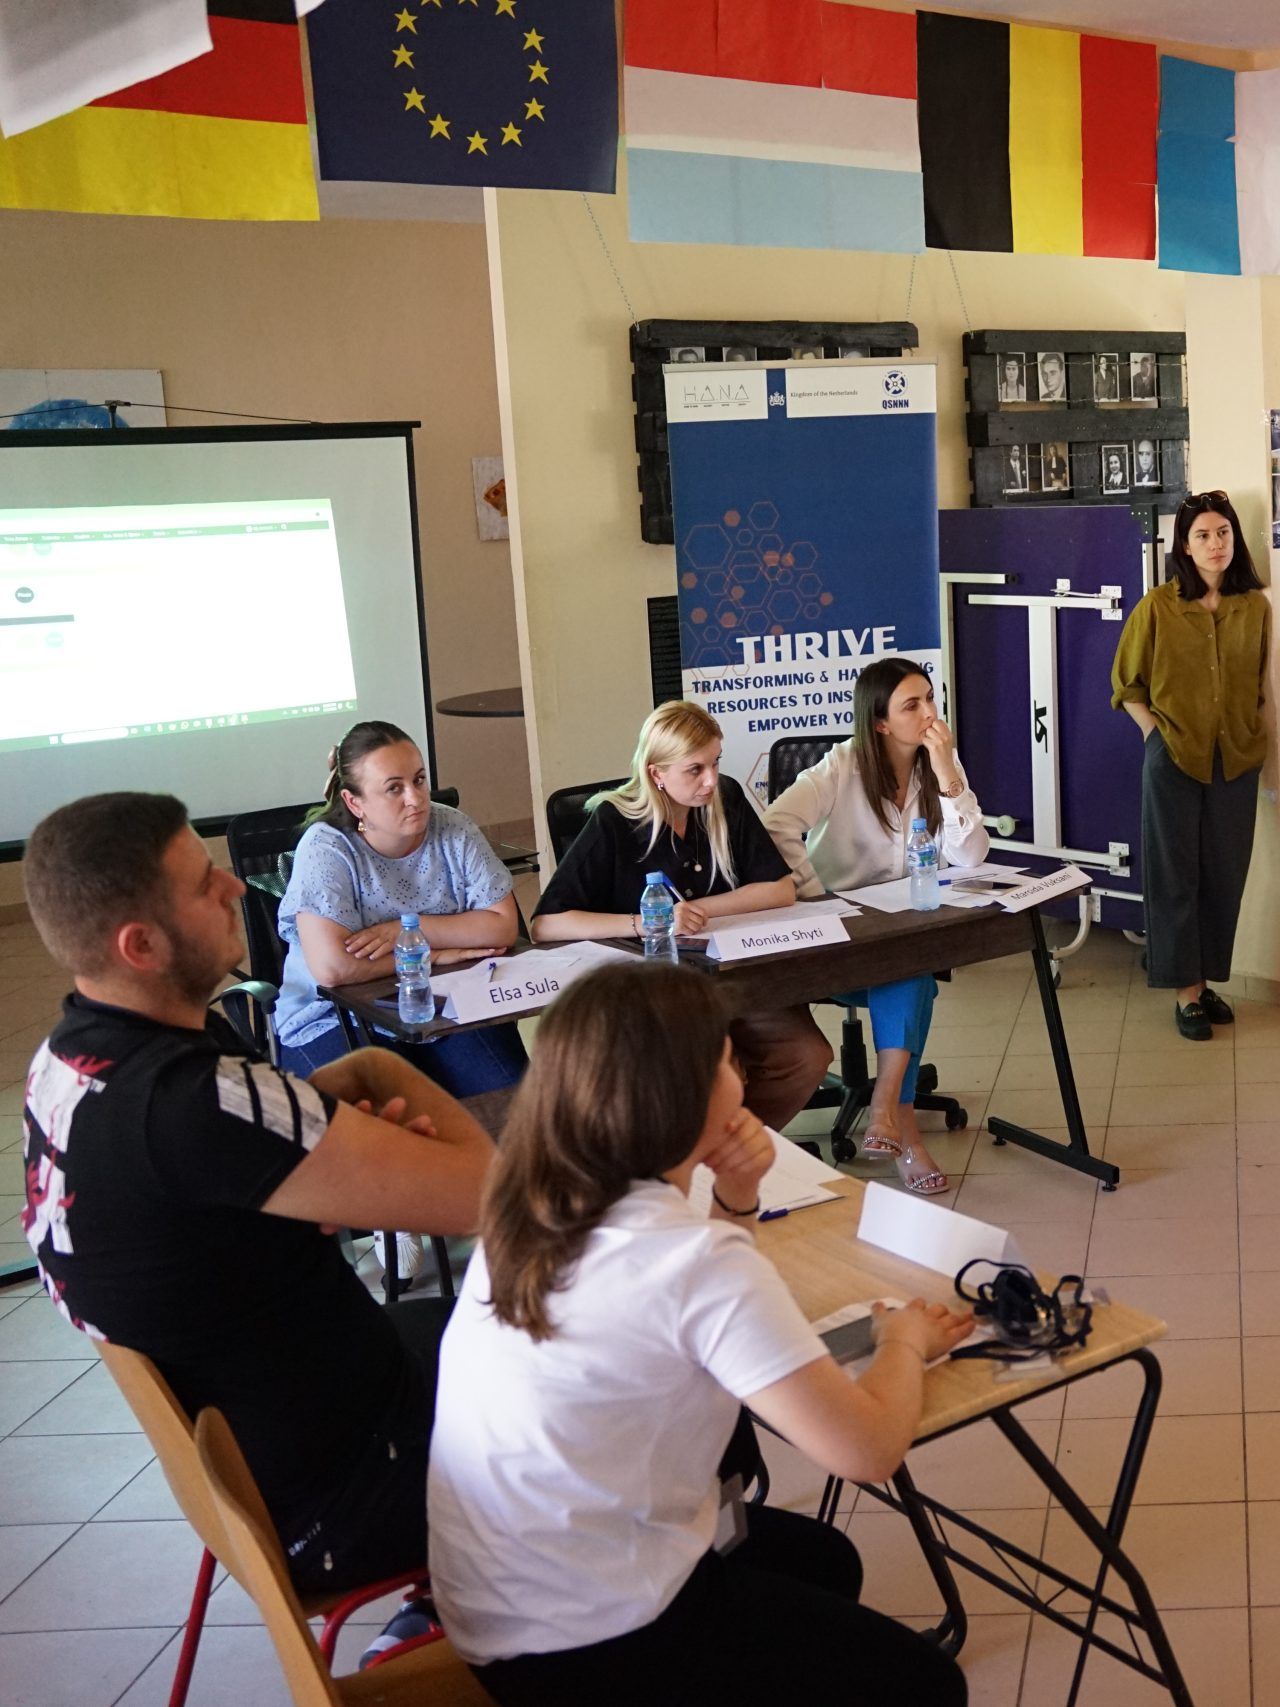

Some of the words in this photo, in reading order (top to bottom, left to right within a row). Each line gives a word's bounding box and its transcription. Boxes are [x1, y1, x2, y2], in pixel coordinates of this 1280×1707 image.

[735, 625, 898, 665] THRIVE
[692, 671, 815, 694] TRANSFORMING
[819, 670, 829, 683] &
[707, 694, 798, 714] RESOURCES
[803, 692, 823, 706] TO
[748, 713, 828, 733] EMPOWER
[741, 934, 790, 949] Monika
[791, 928, 824, 941] Shyti
[489, 987, 522, 1004] Elsa
[525, 978, 560, 996] Sula
